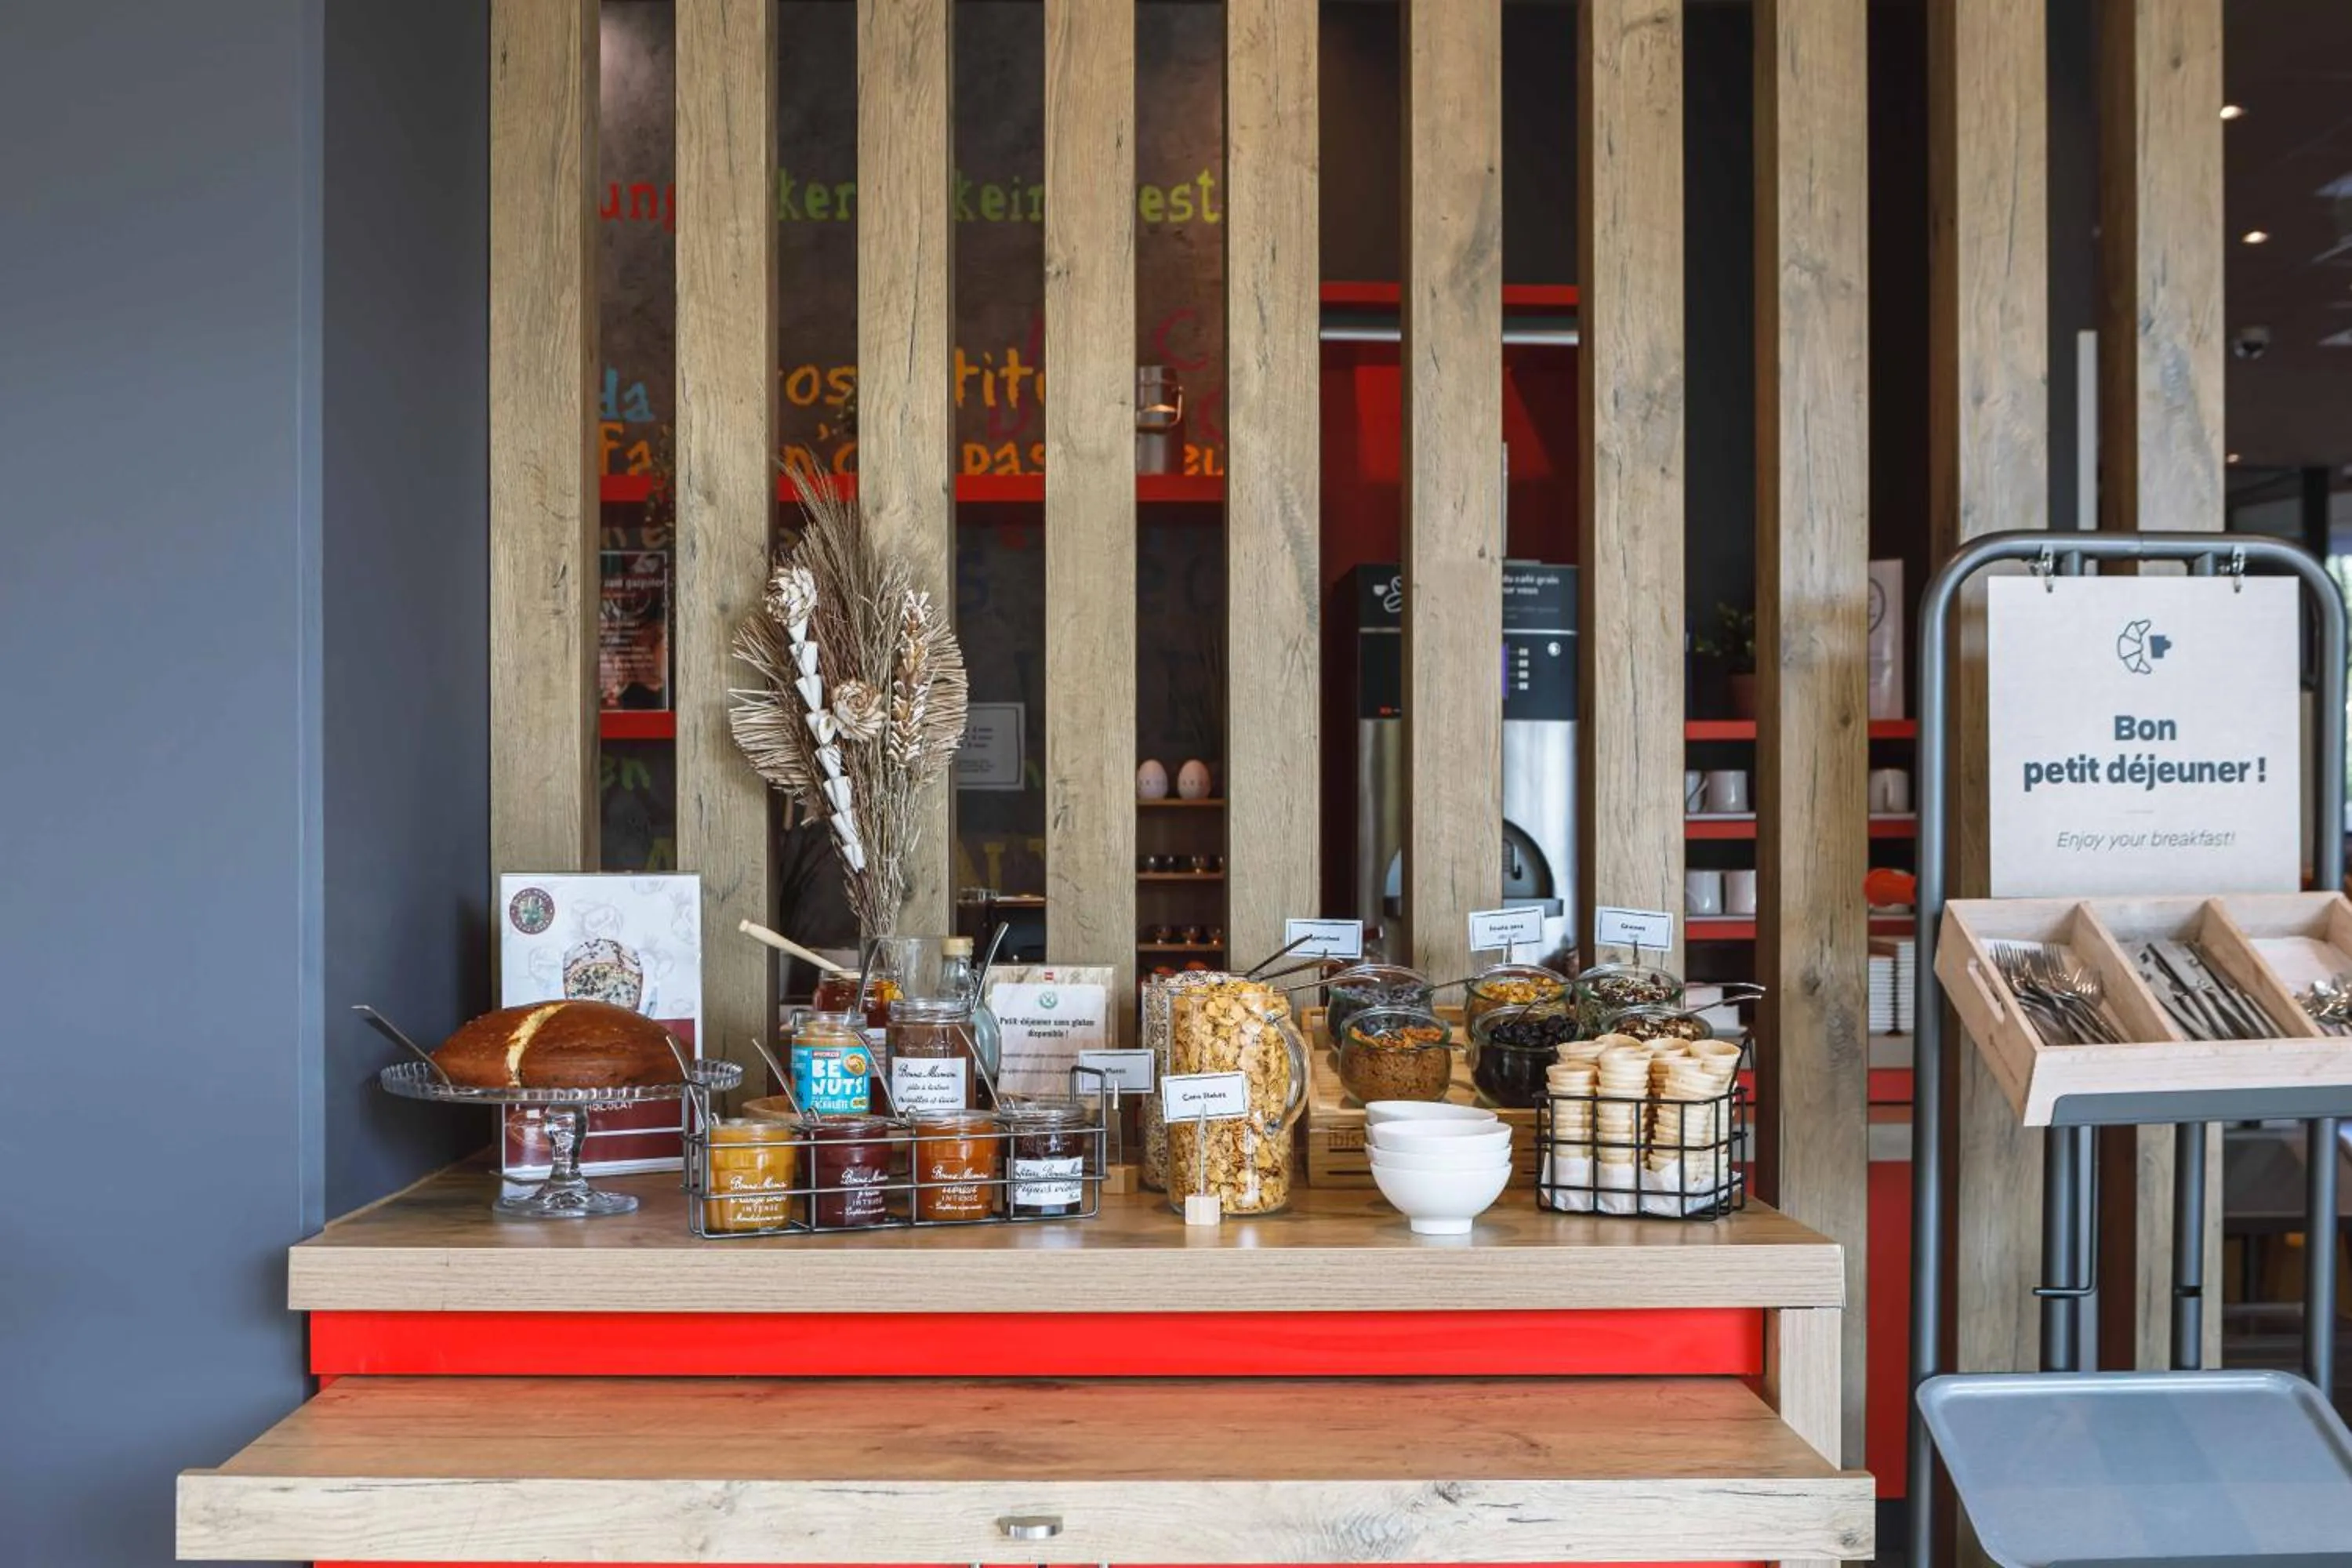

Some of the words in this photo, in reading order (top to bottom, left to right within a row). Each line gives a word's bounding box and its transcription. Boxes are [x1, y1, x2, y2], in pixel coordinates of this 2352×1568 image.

[1139, 168, 1221, 223] est
[2114, 715, 2176, 741] Bon
[2024, 754, 2100, 792] petit
[2107, 753, 2251, 790] déjeuner
[2259, 757, 2267, 782] !
[2056, 832, 2104, 851] Enjoy
[2109, 836, 2147, 851] your
[2151, 830, 2235, 848] breakfast!
[811, 1059, 841, 1078] BE
[811, 1077, 867, 1095] NUTS!
